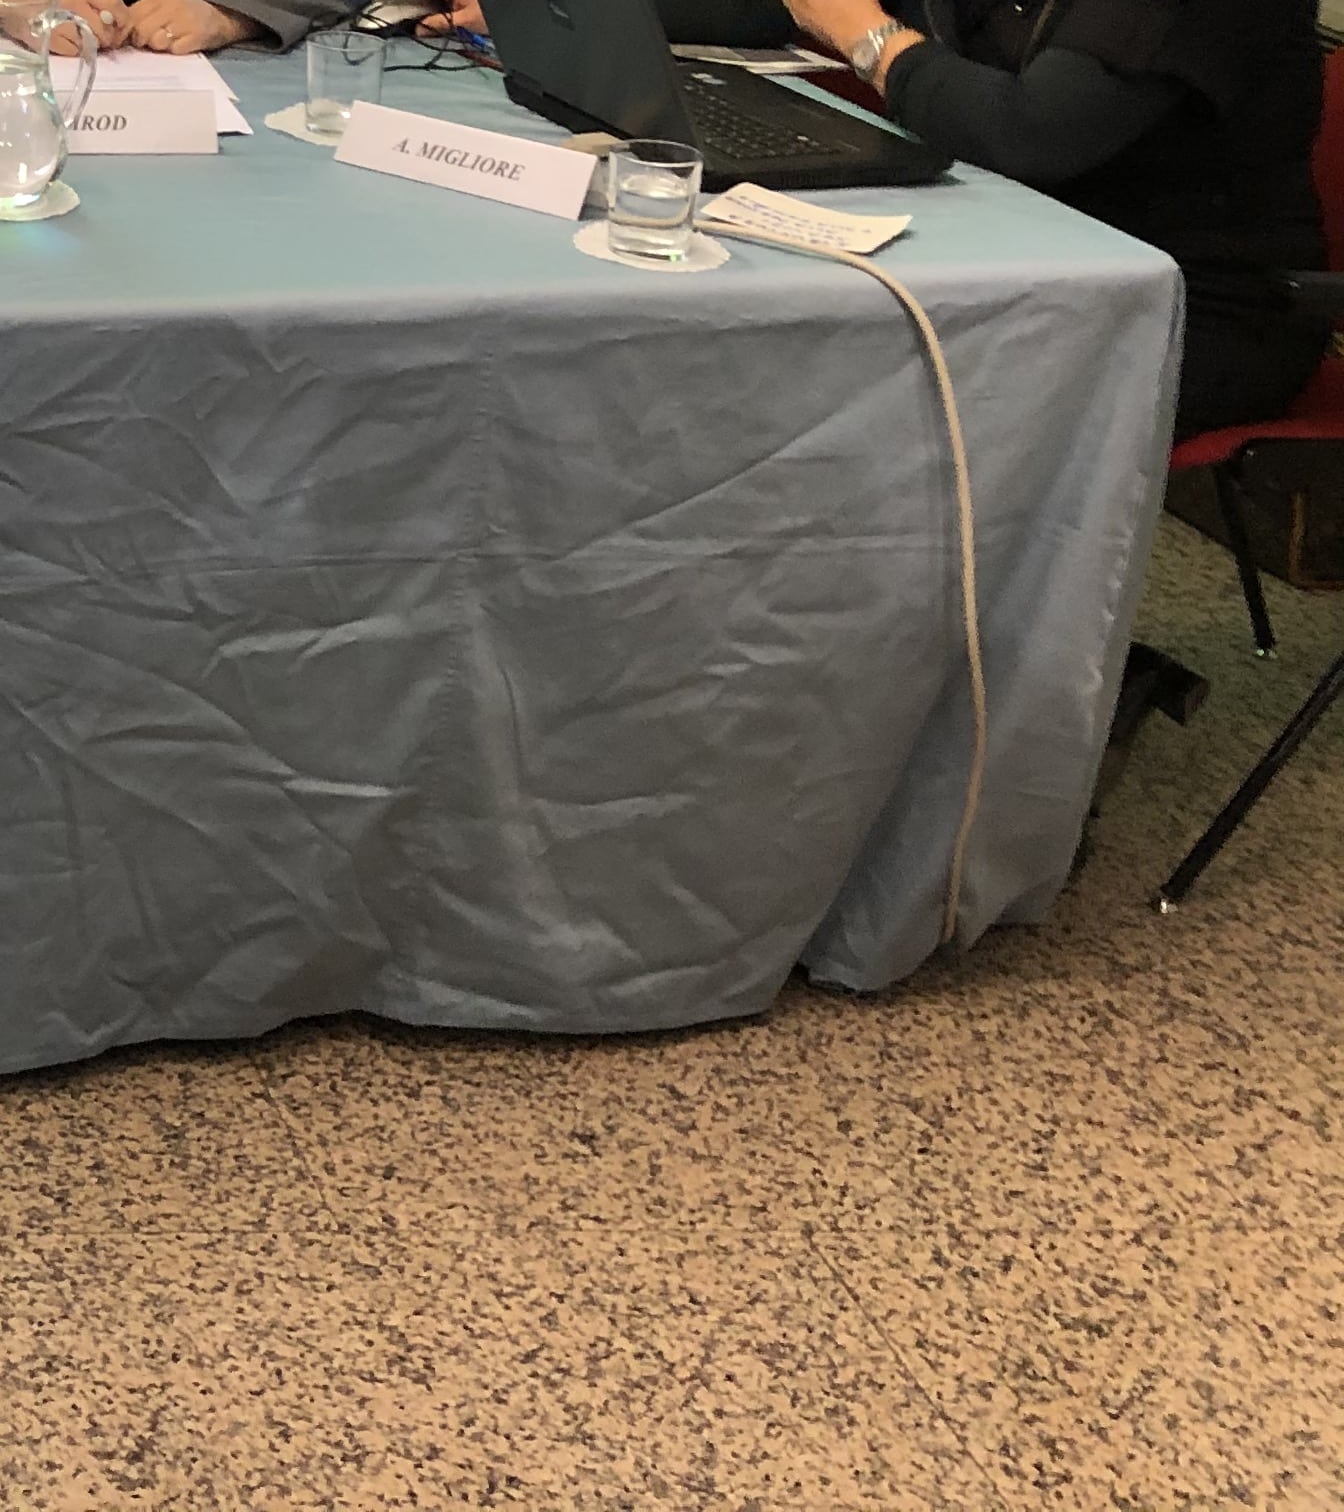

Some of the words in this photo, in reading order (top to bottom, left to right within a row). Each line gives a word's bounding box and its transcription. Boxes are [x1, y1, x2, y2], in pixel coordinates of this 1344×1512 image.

[70, 114, 128, 132] IROD
[392, 138, 410, 154] A.
[416, 141, 526, 181] MIGLIORE
